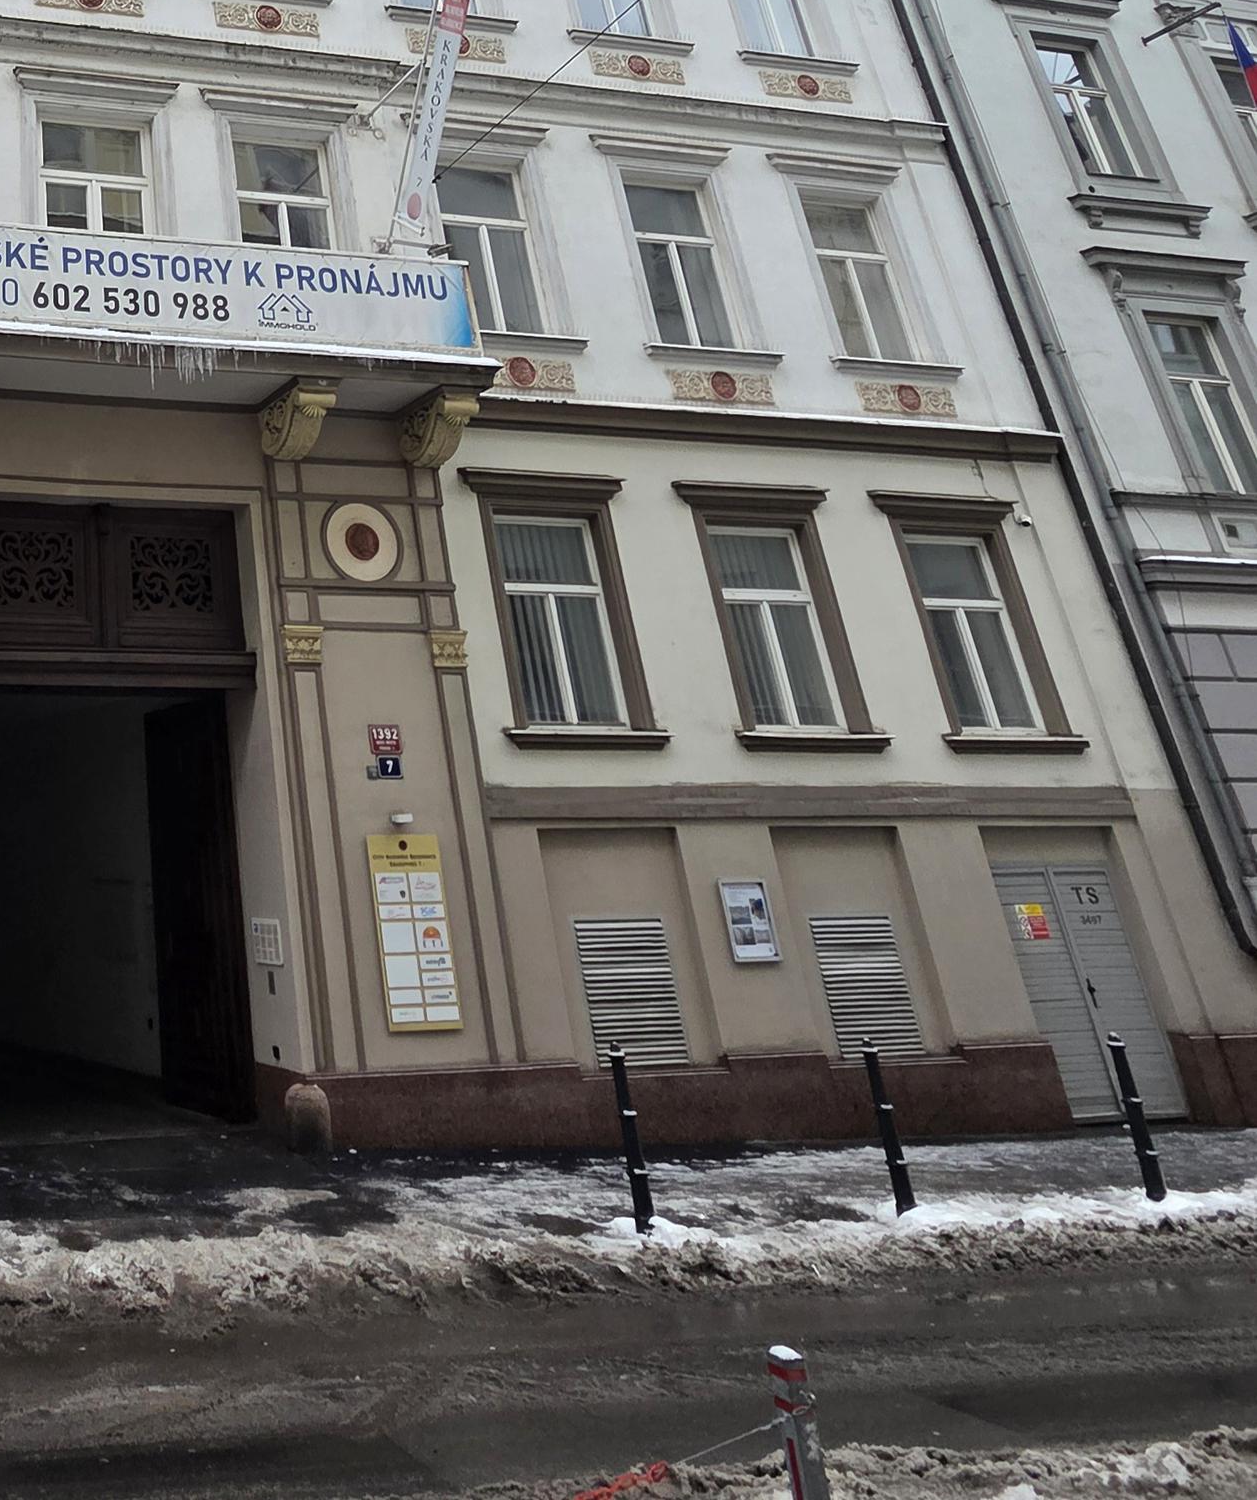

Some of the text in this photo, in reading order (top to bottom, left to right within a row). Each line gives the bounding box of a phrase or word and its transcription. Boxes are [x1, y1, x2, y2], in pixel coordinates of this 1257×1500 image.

[62, 247, 232, 285] PROSTORY
[243, 261, 265, 288] K
[275, 263, 448, 301] PRONÁJMU
[33, 282, 91, 312] 602
[103, 287, 160, 317] 530
[173, 292, 230, 321] 988
[372, 728, 399, 740] 1392
[386, 760, 393, 773] 7
[1070, 886, 1100, 905] TS
